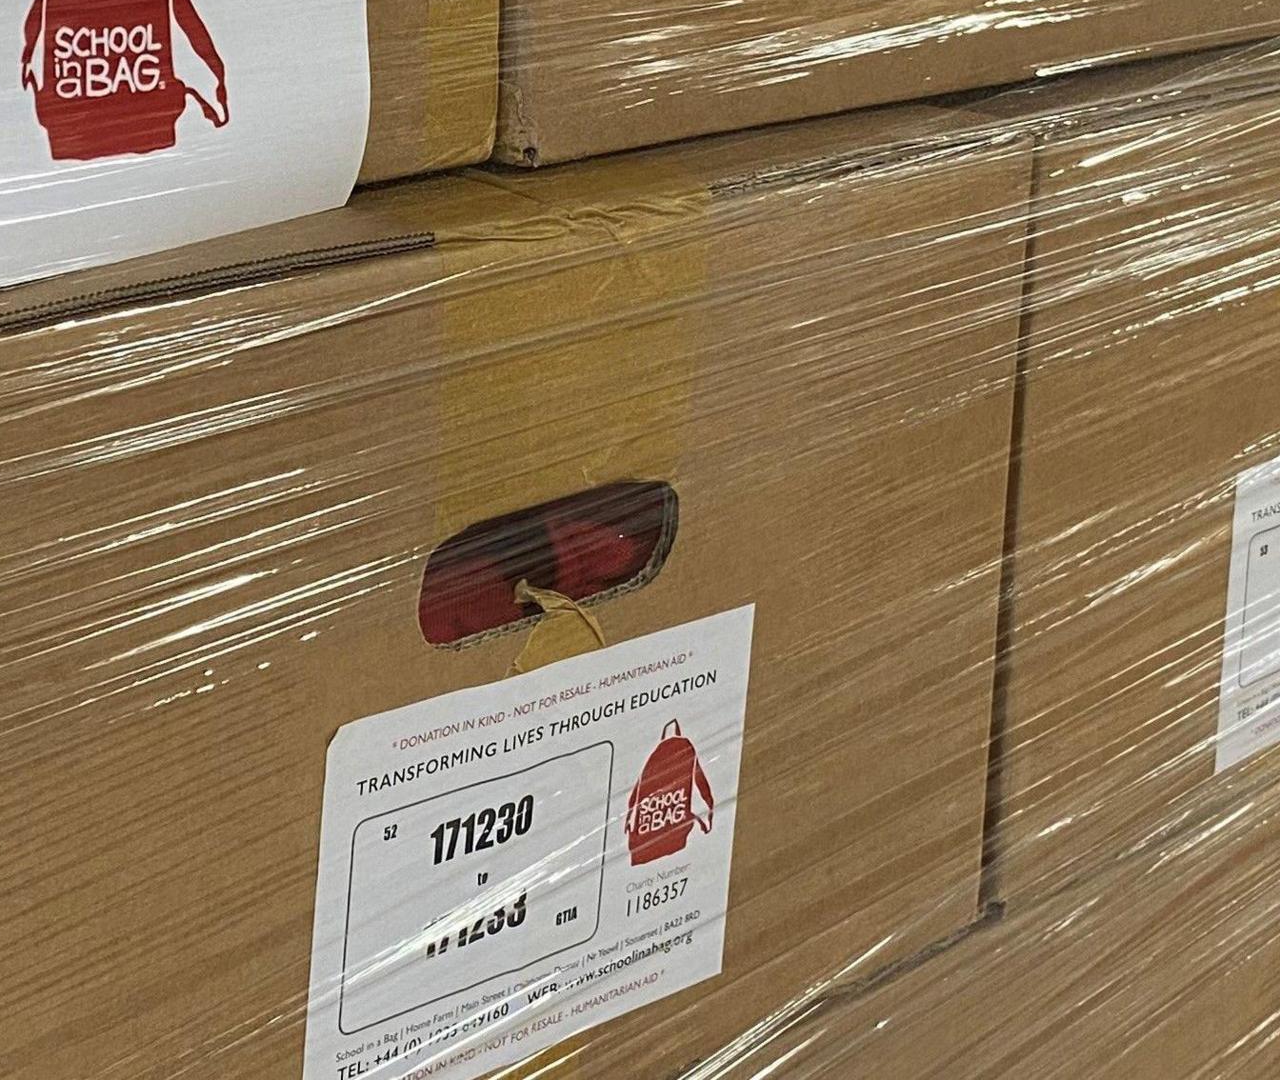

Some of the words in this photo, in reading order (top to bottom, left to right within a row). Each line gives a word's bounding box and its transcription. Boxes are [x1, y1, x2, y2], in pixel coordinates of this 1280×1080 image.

[53, 24, 162, 59] SCHOOL
[53, 58, 81, 79] in
[86, 54, 161, 98] BAG
[399, 723, 460, 751] DONATION
[462, 719, 475, 733] IN
[477, 711, 507, 728] KIND
[512, 701, 536, 719] NOT
[538, 693, 558, 711] FOR
[559, 682, 592, 704] RESALE
[598, 659, 671, 689] HUMANITARIAN
[356, 741, 497, 797] TRANSFORMING
[503, 726, 544, 754] LIVES
[549, 700, 626, 738] THROUGH
[630, 669, 718, 711] EDUCATION
[639, 787, 688, 815] SCHOOL
[430, 794, 535, 866] 171230
[650, 803, 686, 831] BAG
[383, 824, 399, 842] 52
[627, 877, 689, 918] 1186357
[555, 906, 578, 926] GTIA
[335, 1043, 365, 1063] School
[337, 1061, 370, 1080] TEL:
